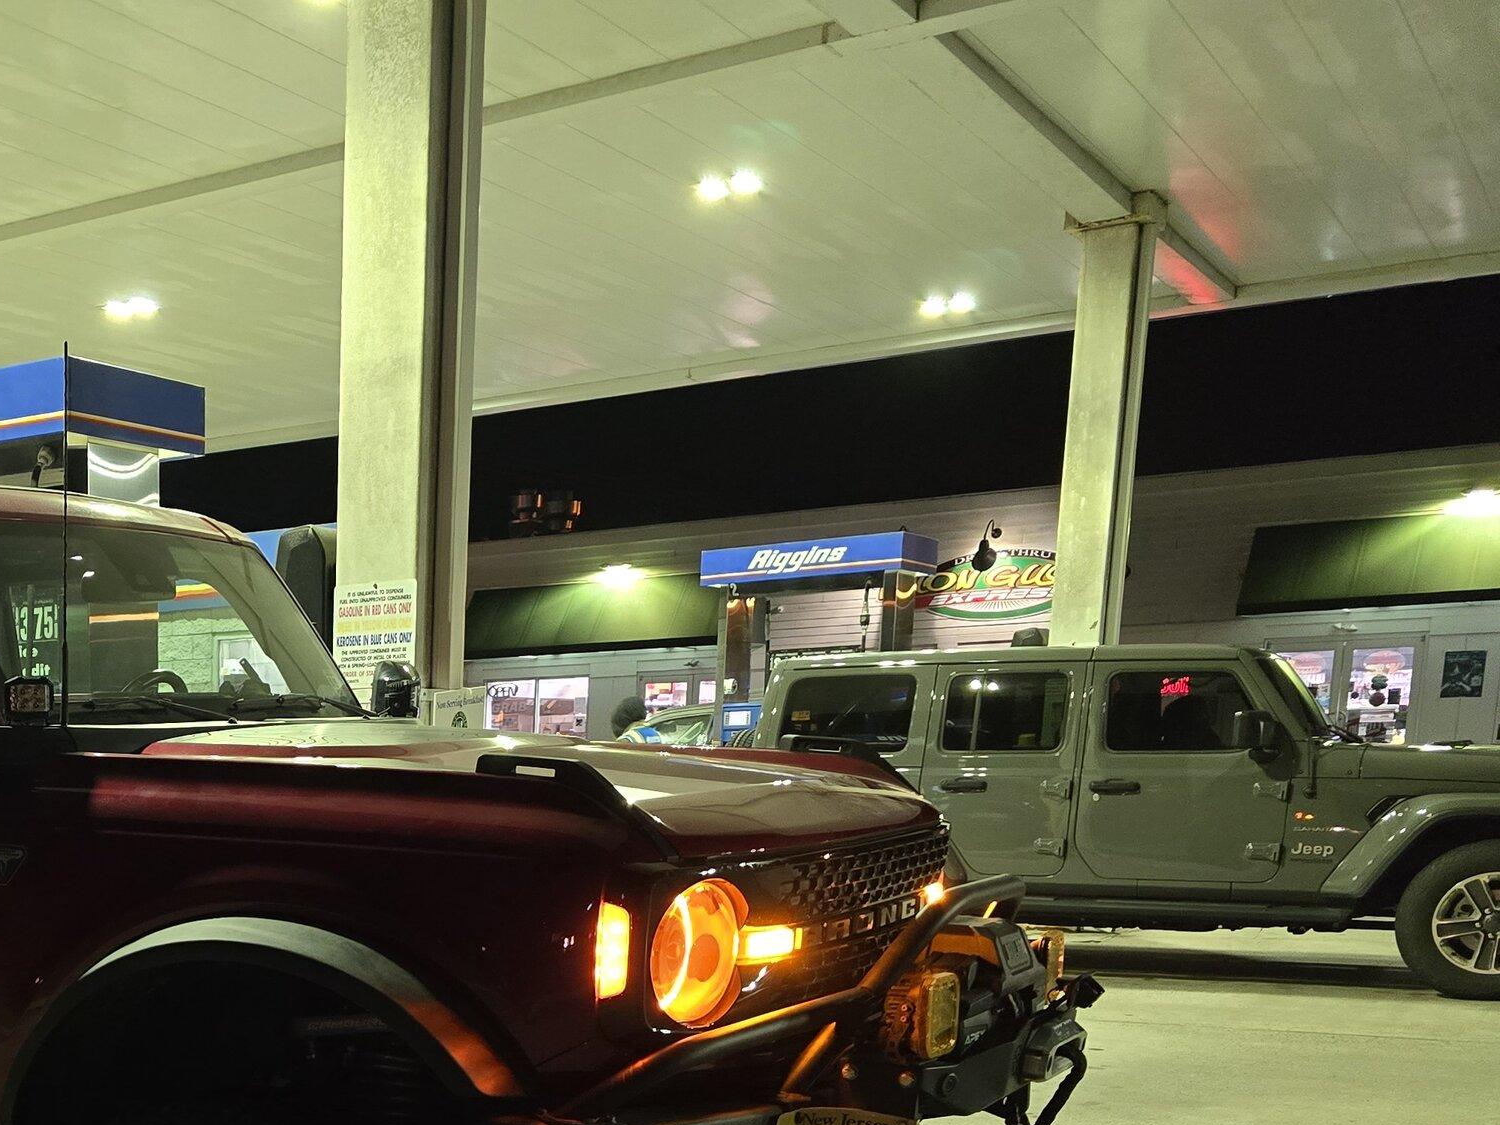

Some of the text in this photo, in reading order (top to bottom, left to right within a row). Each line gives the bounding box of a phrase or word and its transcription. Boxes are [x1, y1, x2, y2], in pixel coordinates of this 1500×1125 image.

[747, 546, 848, 575] Riggins
[1009, 549, 1052, 559] THRU
[929, 586, 1055, 607] EXPRES
[339, 602, 412, 618] GASOLINE IN RED CANS ONLY
[336, 631, 412, 647] KEROSENE IN BLUE CANS ONLY
[487, 683, 518, 699] OPEN
[493, 702, 527, 714] GRAB
[1291, 842, 1334, 858] Jeep
